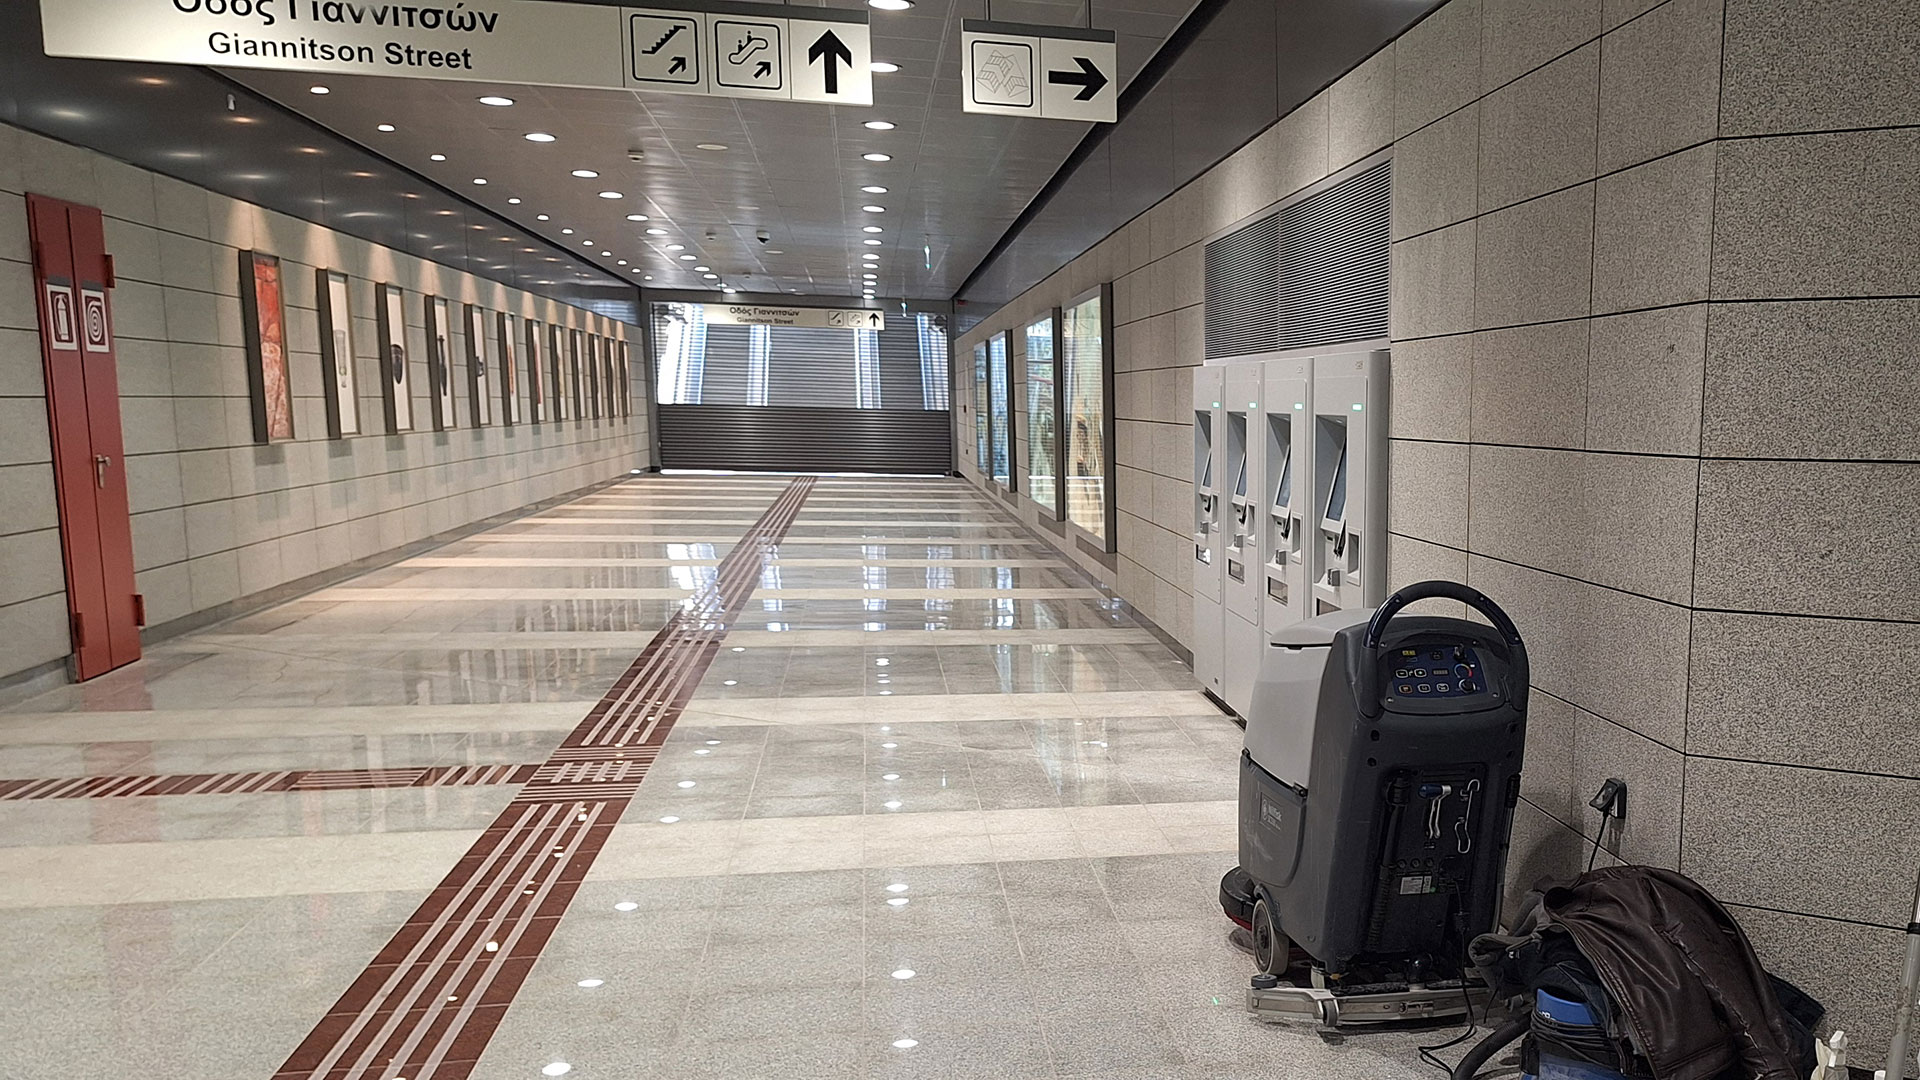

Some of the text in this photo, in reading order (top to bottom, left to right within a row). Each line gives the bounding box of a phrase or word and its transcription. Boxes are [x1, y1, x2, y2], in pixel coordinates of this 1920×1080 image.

[208, 31, 472, 70] Giannitson Street
[729, 307, 800, 316] Οδός Γιαννιτσών
